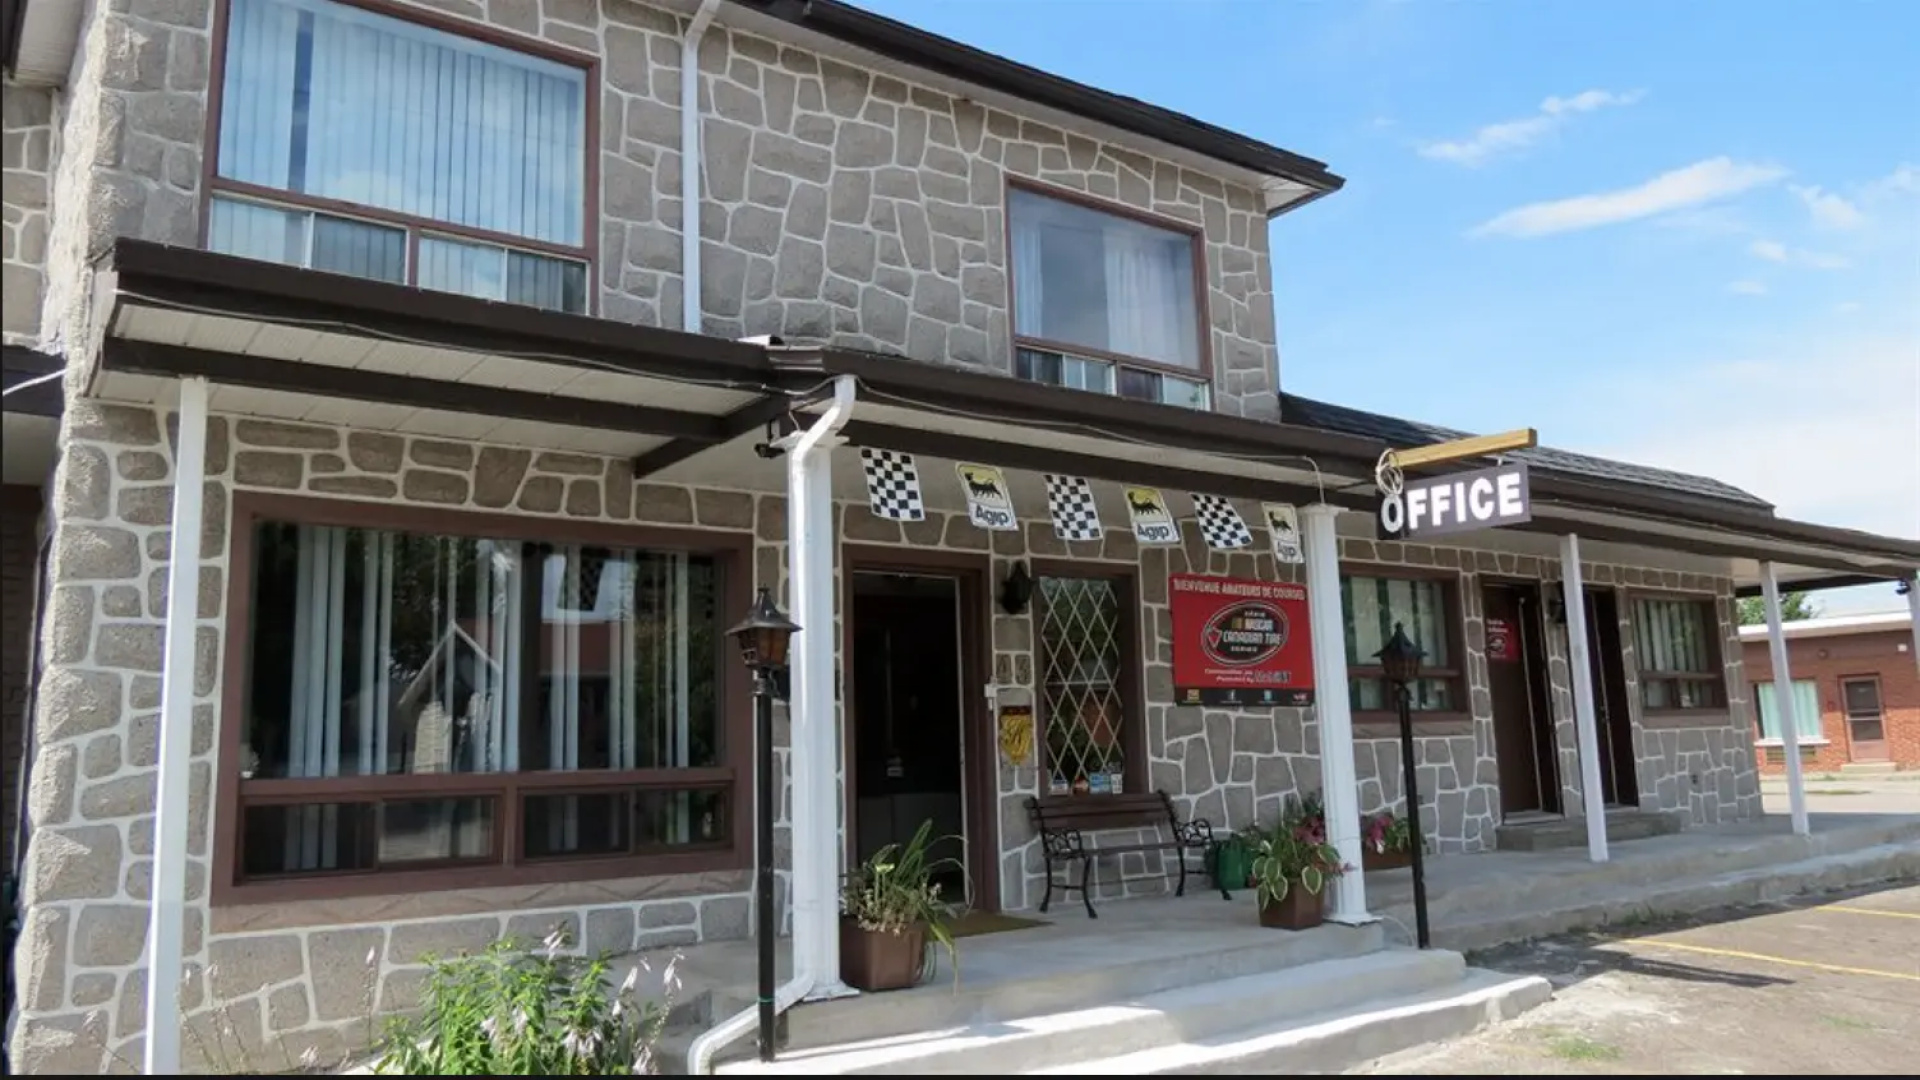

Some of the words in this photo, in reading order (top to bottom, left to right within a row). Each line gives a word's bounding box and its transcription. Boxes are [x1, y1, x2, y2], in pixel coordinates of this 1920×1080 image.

[1381, 472, 1524, 533] OFFICE
[976, 504, 1008, 526] Agip
[1137, 523, 1169, 541] Agip
[1174, 578, 1220, 594] BIENVENUE
[1222, 582, 1261, 597] AMATEURS
[1262, 587, 1273, 598] DE
[1223, 631, 1264, 644] CANADIAN
